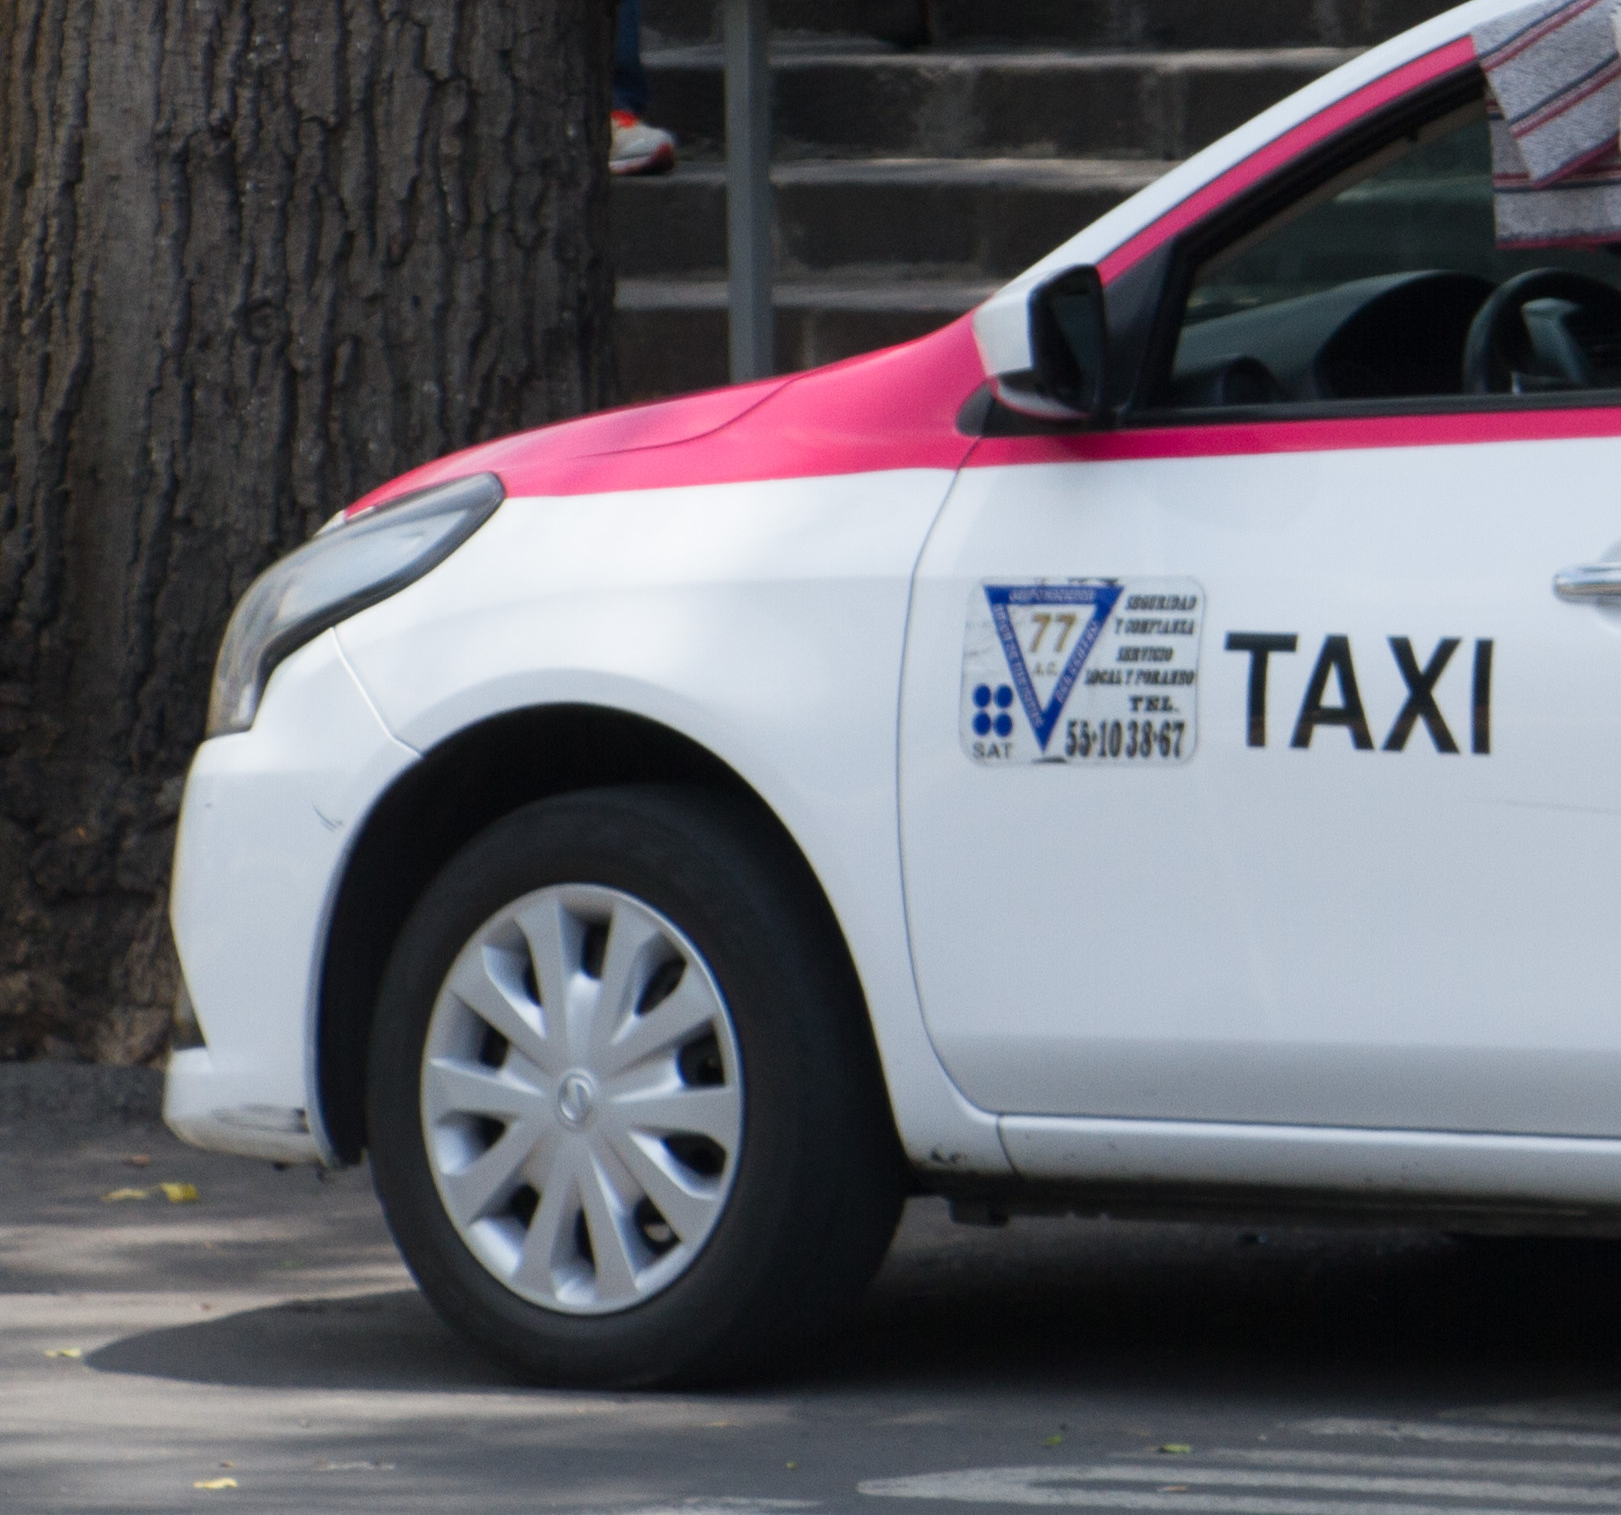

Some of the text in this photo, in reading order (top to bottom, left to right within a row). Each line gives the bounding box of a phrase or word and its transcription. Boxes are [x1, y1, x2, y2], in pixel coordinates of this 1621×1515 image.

[1028, 611, 1078, 653] 77
[1129, 695, 1179, 713] TEL.
[1224, 631, 1494, 755] TAXI
[972, 742, 1012, 760] SAT
